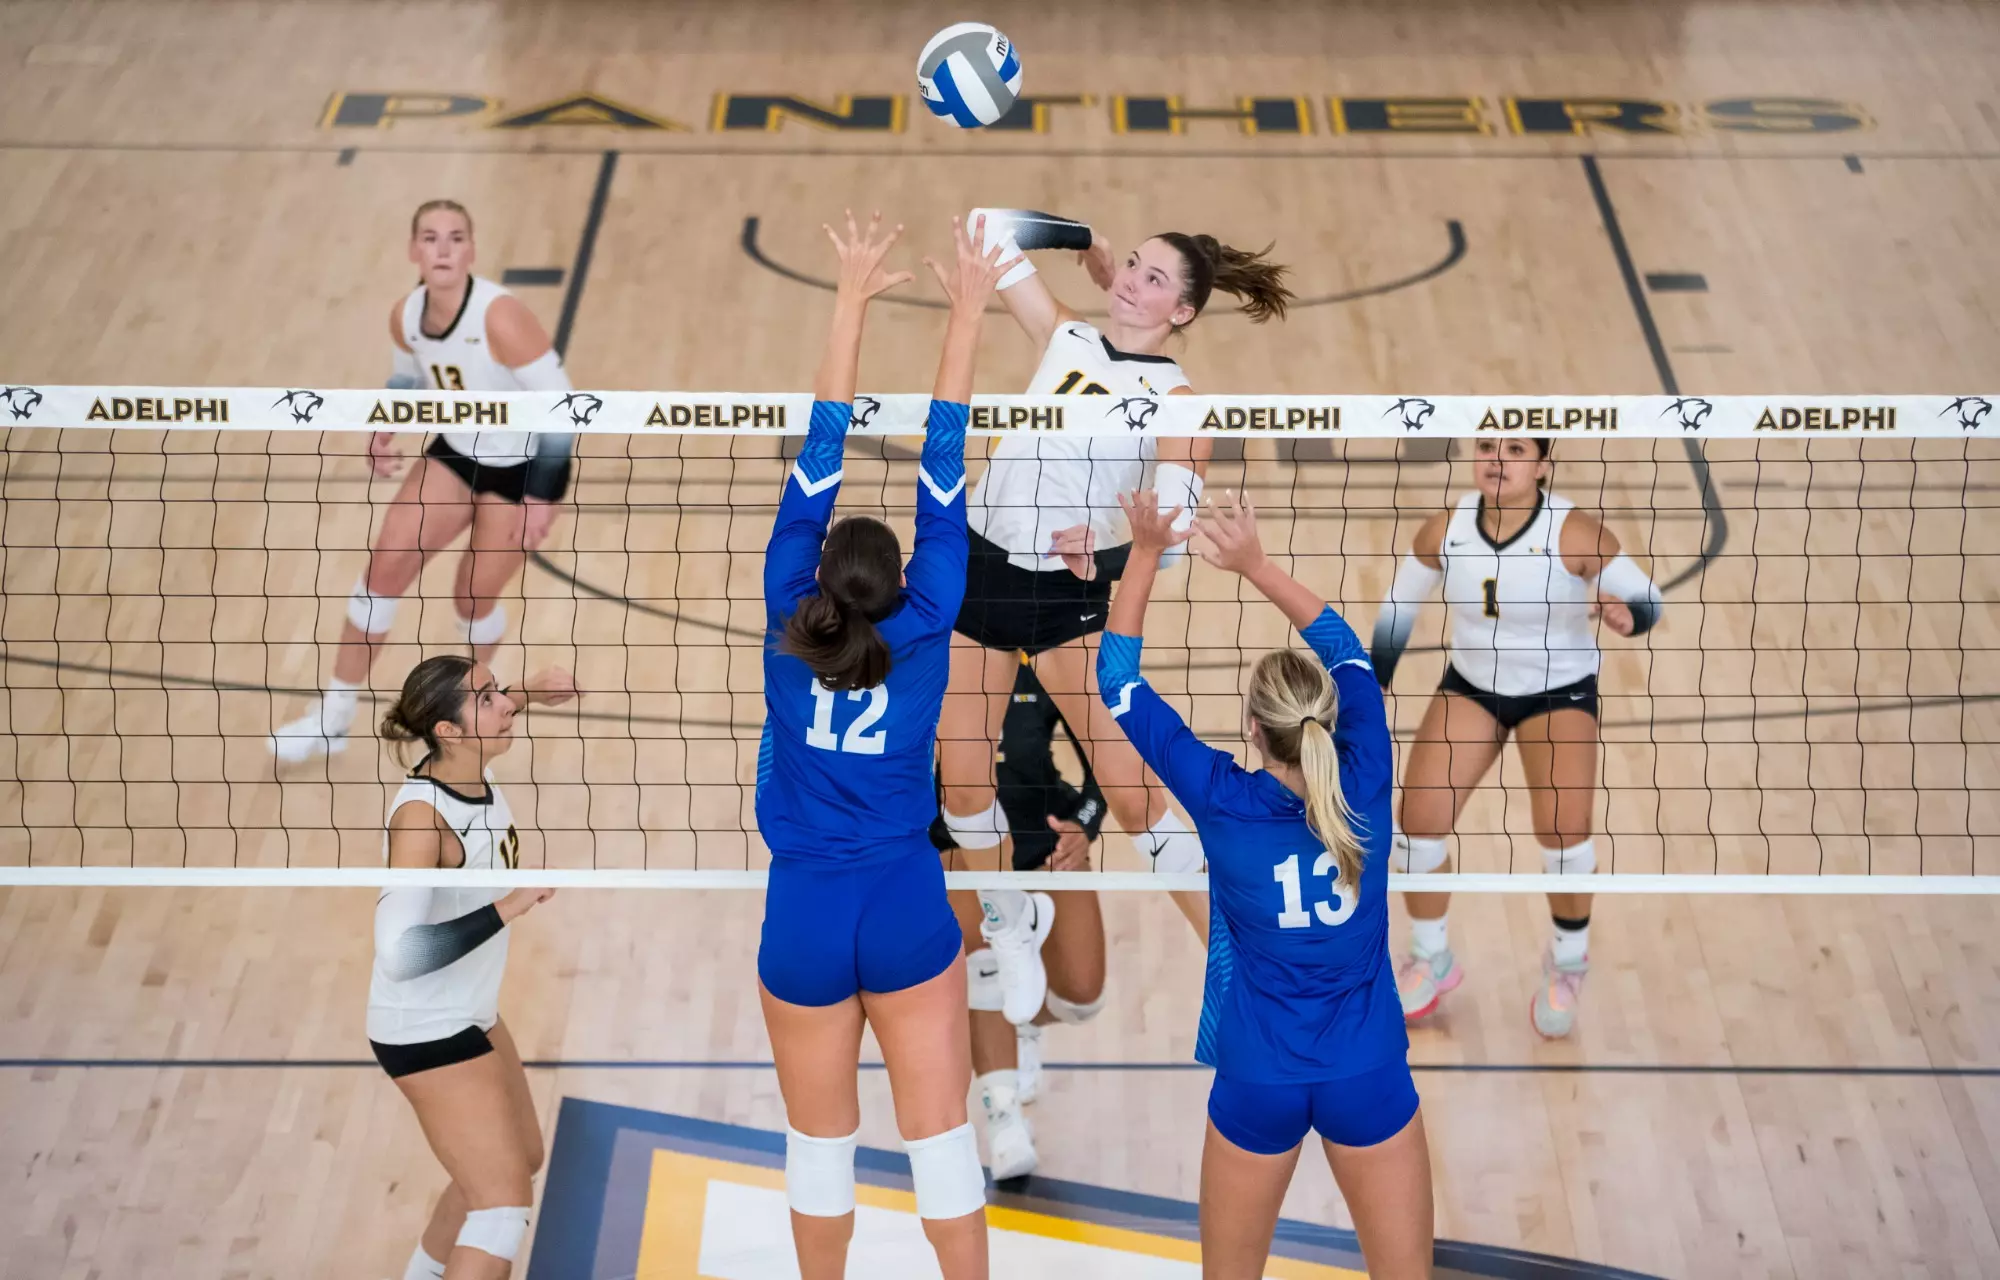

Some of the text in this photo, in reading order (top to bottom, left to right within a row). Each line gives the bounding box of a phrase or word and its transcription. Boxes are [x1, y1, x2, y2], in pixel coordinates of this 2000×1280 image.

[318, 91, 1876, 134] PANTHERS
[85, 396, 1896, 431] ADELPHI ADELPHI ADELPHI ELPHI ADELPHI ADELPHI ADELPHI
[1482, 578, 1499, 618] 1
[806, 678, 889, 754] 12
[1273, 851, 1359, 928] 13
